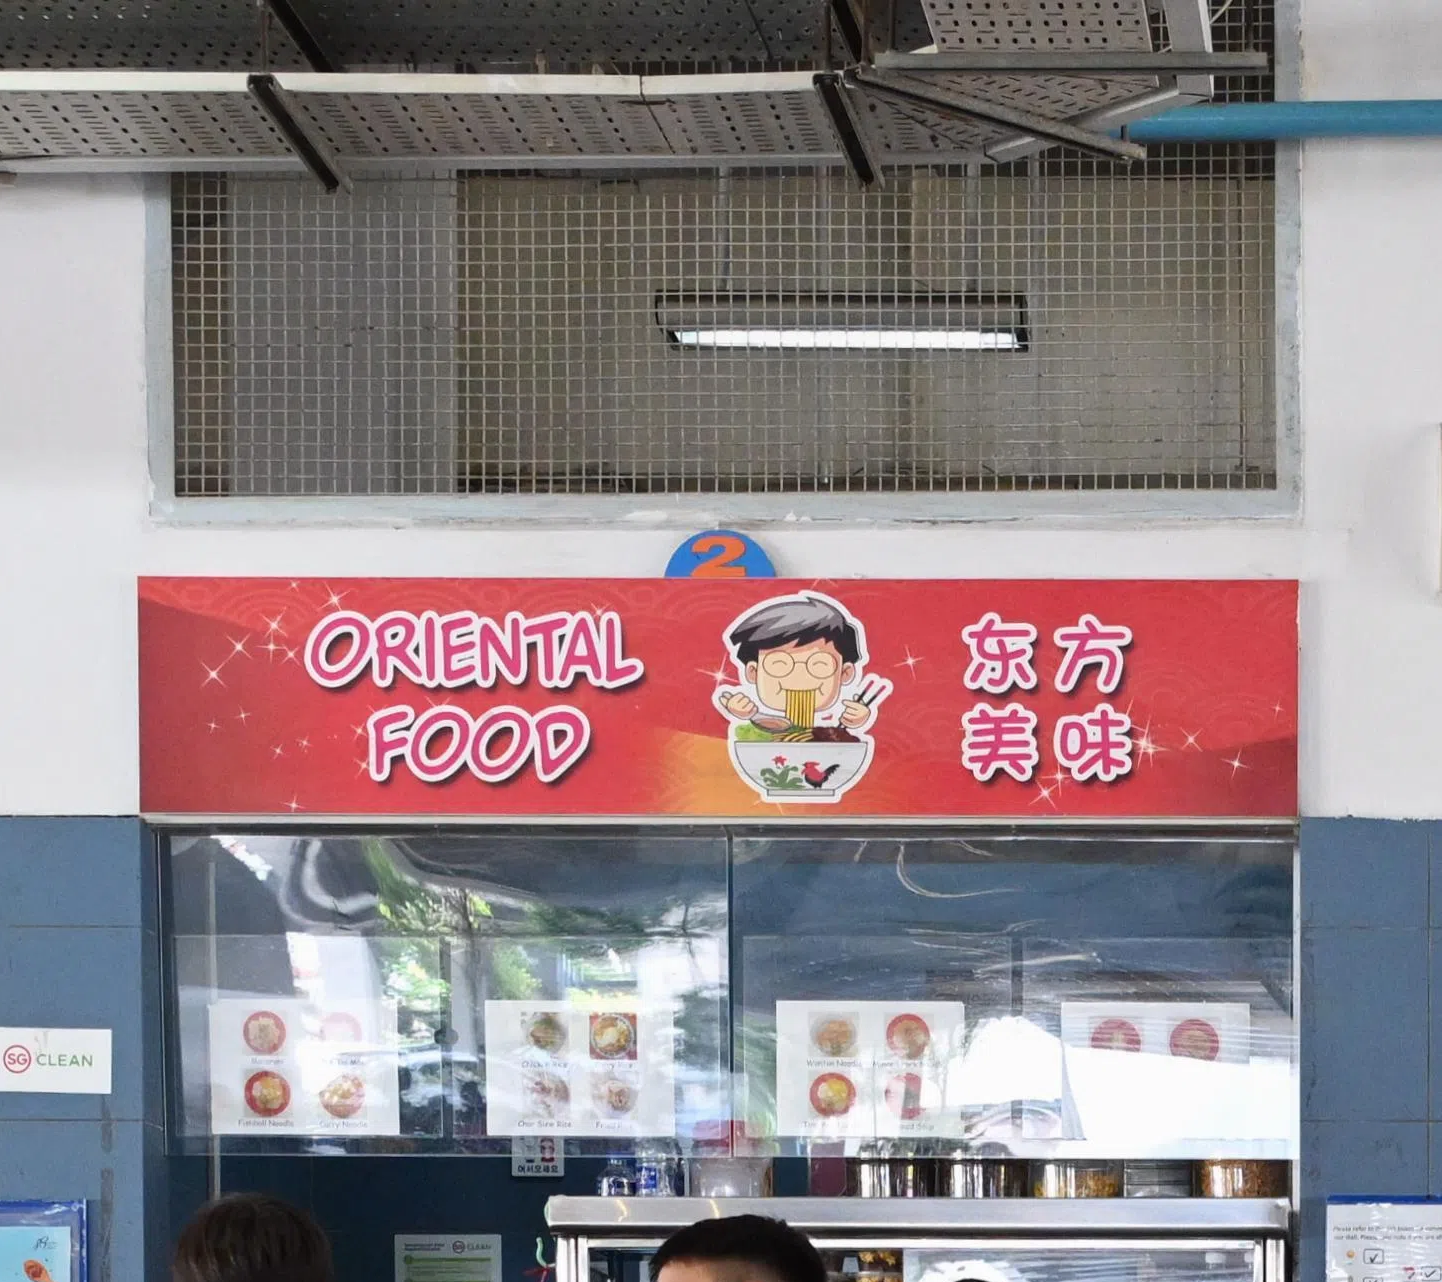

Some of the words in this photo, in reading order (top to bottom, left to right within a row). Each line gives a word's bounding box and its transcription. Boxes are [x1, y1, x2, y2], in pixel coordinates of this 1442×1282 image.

[690, 536, 748, 578] 2
[306, 611, 643, 690] ORIENTAL
[963, 613, 1132, 694] 东方
[369, 705, 591, 783] FOOD
[963, 709, 1132, 783] 美味
[6, 1053, 29, 1067] SG
[36, 1053, 94, 1068] CLEAN
